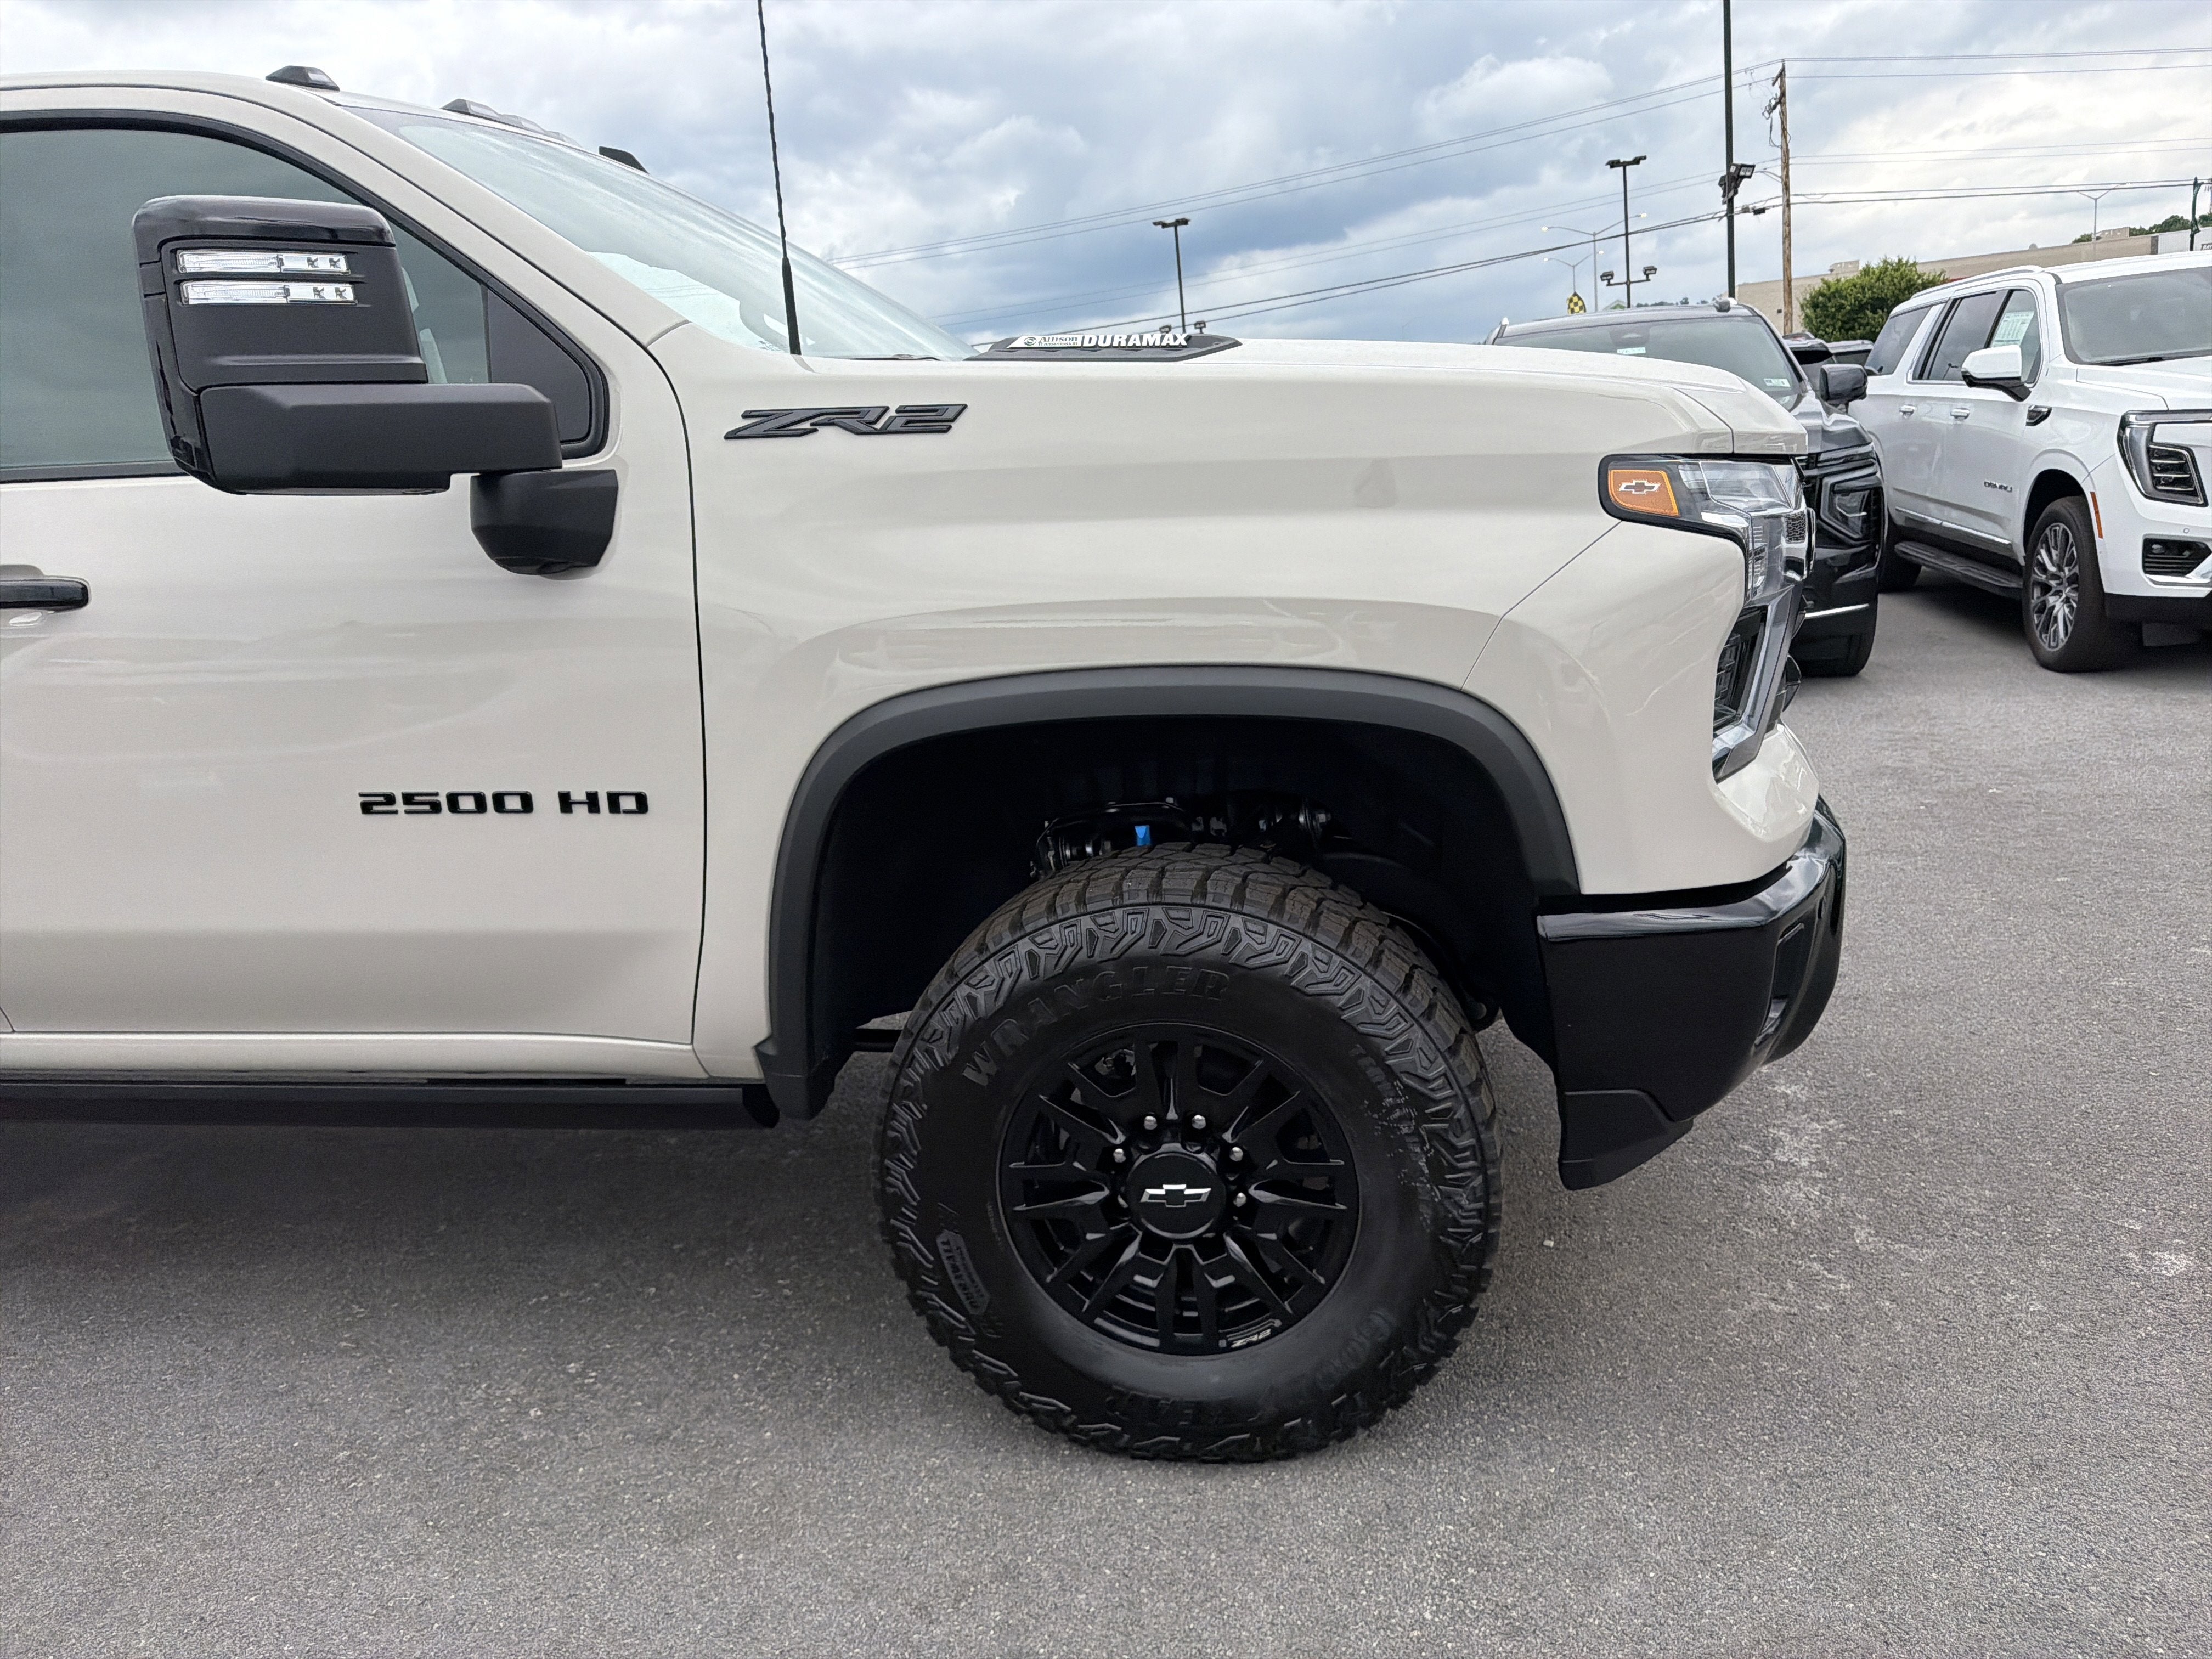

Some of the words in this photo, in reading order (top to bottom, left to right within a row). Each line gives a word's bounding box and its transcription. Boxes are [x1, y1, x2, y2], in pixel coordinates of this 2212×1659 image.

[1083, 333, 1188, 347] DURAMAX
[724, 404, 968, 439] ZR2
[358, 791, 534, 814] 2500
[557, 790, 649, 814] HD
[962, 965, 1230, 1086] WRANGLER
[1231, 1328, 1271, 1348] ZR2
